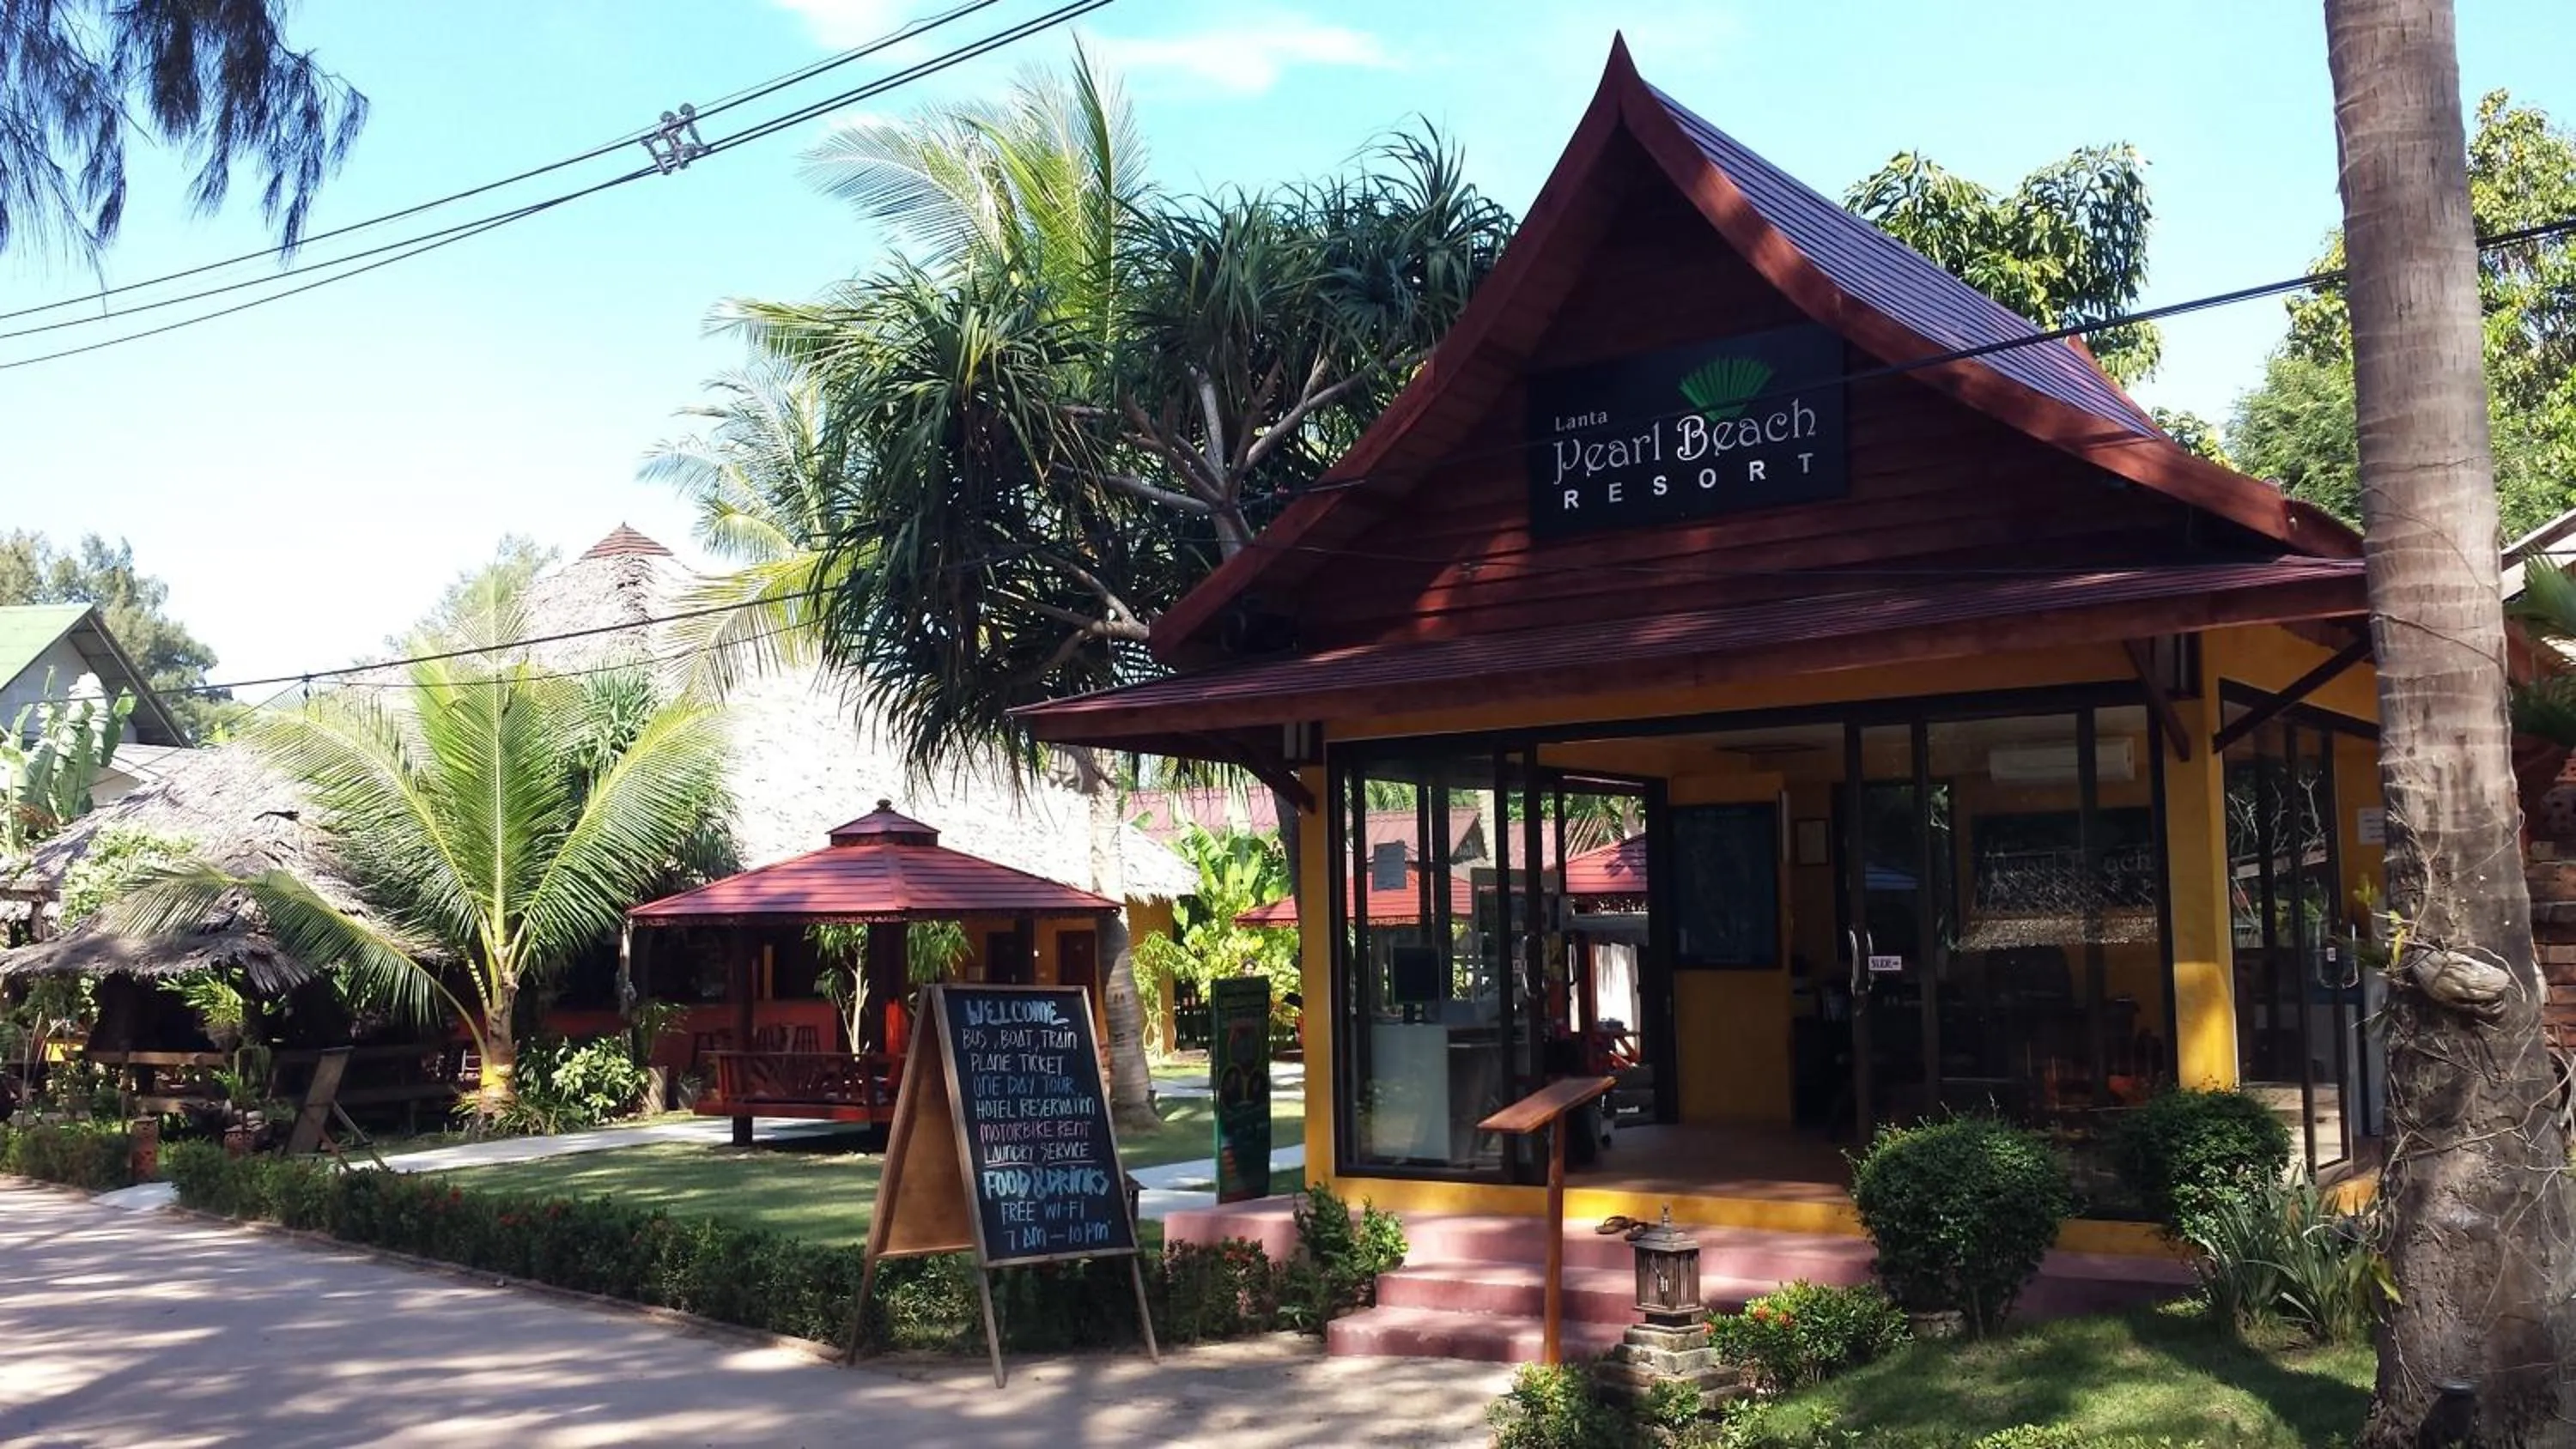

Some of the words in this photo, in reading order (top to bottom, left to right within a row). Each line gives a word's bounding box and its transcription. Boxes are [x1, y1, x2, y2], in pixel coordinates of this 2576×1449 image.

[1555, 410, 1608, 431] Lanta
[1552, 421, 1662, 484] Pearl
[1676, 397, 1816, 461] Beach
[1563, 452, 1814, 509] RESORT
[964, 999, 1070, 1026] WELCOME
[1018, 1049, 1065, 1074] TICKET
[1007, 1075, 1035, 1095] DAY
[1042, 1075, 1074, 1094] TOUR
[976, 1099, 1015, 1119] HOTEL
[979, 1120, 1054, 1143] MOTORBIKE
[1040, 1141, 1090, 1161] SERVICE
[982, 1169, 1031, 1199] FOOD
[1000, 1201, 1036, 1225] FREE
[1002, 1229, 1017, 1251] 7
[1023, 1225, 1048, 1249] AM
